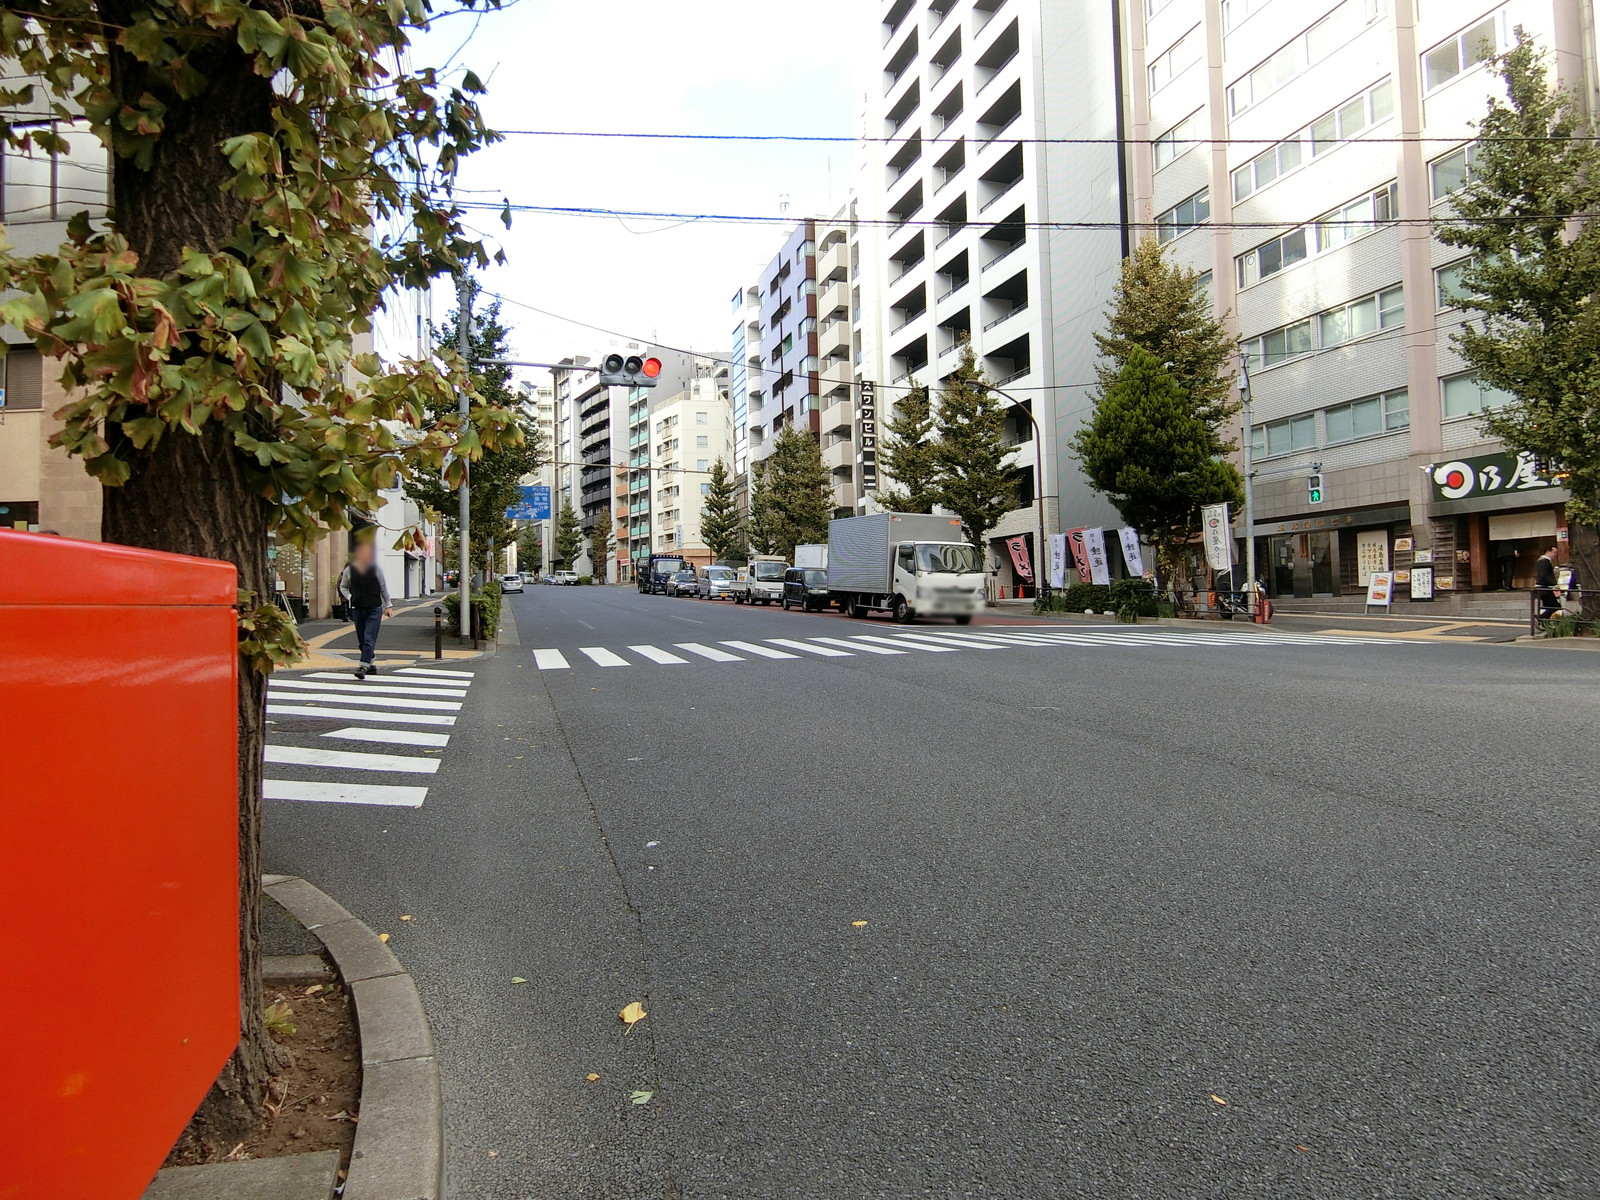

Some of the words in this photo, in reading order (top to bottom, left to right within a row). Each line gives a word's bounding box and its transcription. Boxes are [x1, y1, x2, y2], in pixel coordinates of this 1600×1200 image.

[863, 382, 873, 446] スワンビル
